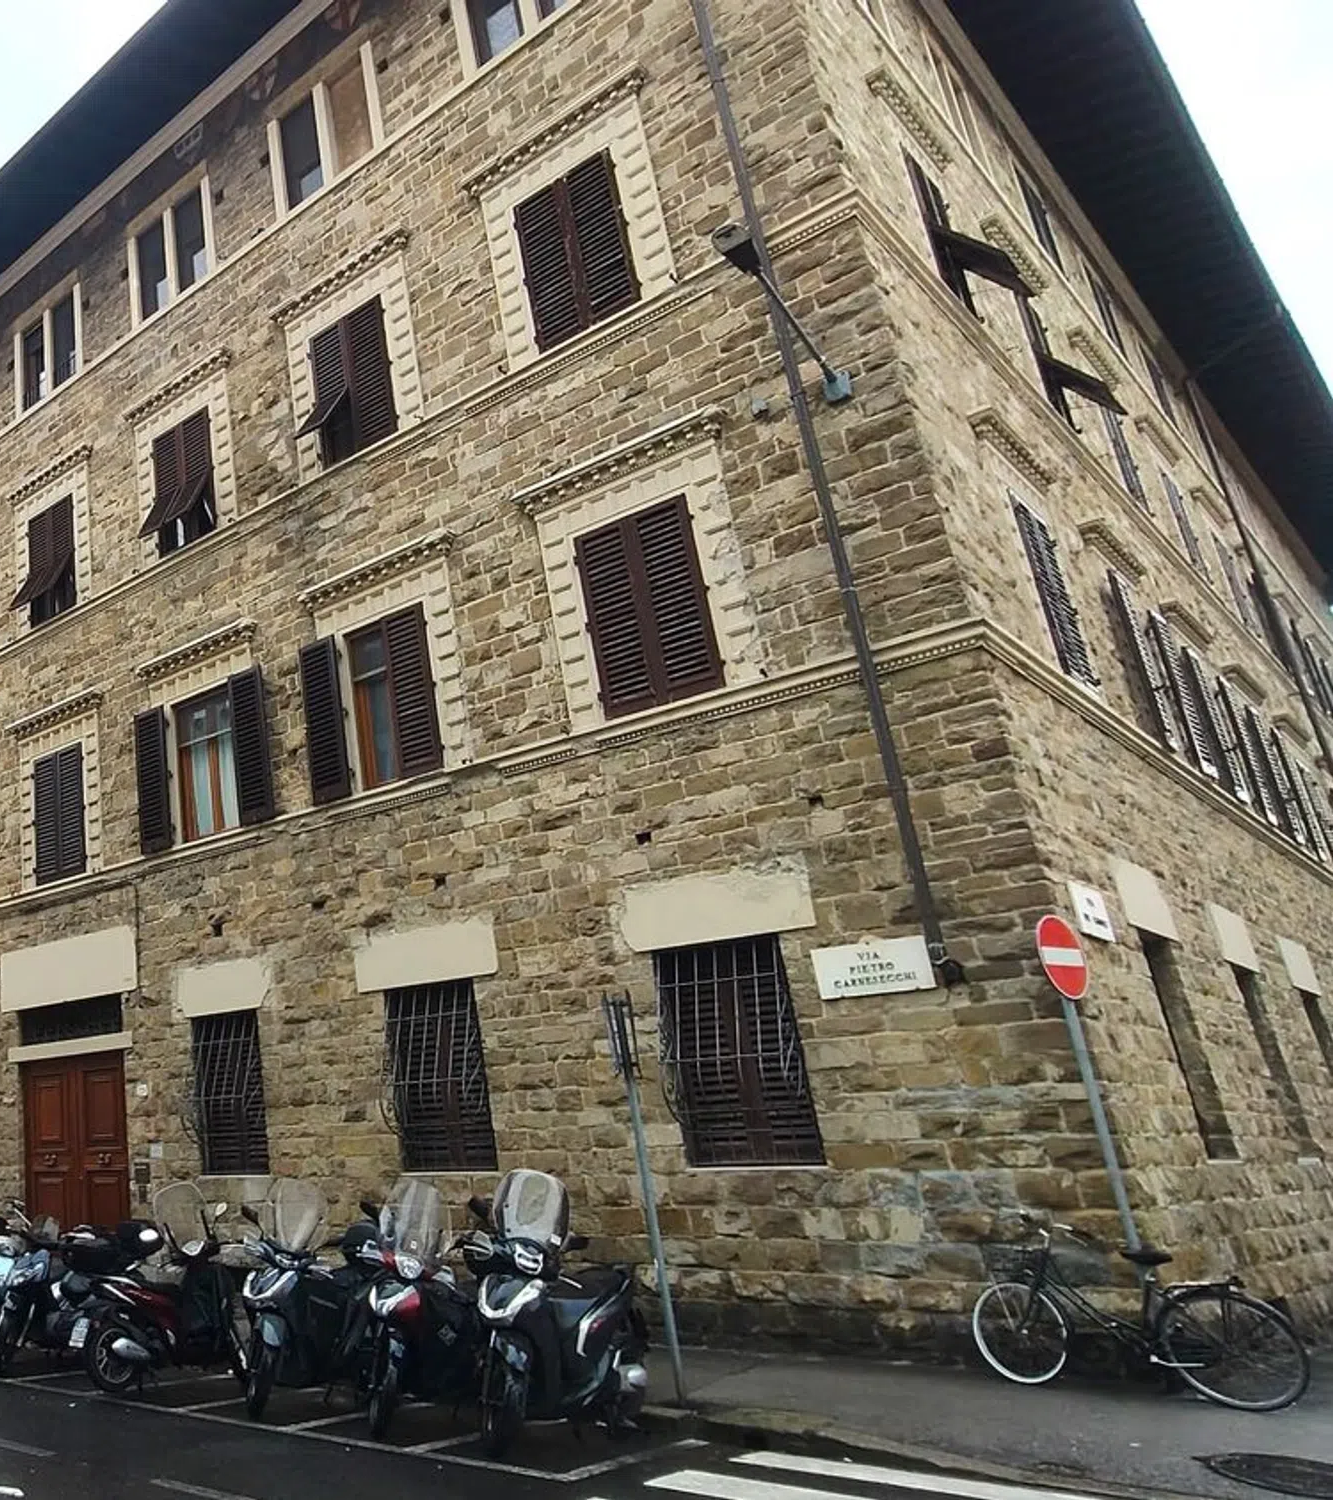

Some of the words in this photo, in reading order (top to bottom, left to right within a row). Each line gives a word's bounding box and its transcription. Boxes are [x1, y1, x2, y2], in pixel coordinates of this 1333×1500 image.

[857, 952, 880, 961] VIA
[849, 962, 895, 974] PIETRO
[833, 972, 917, 989] CARNESECCHI
